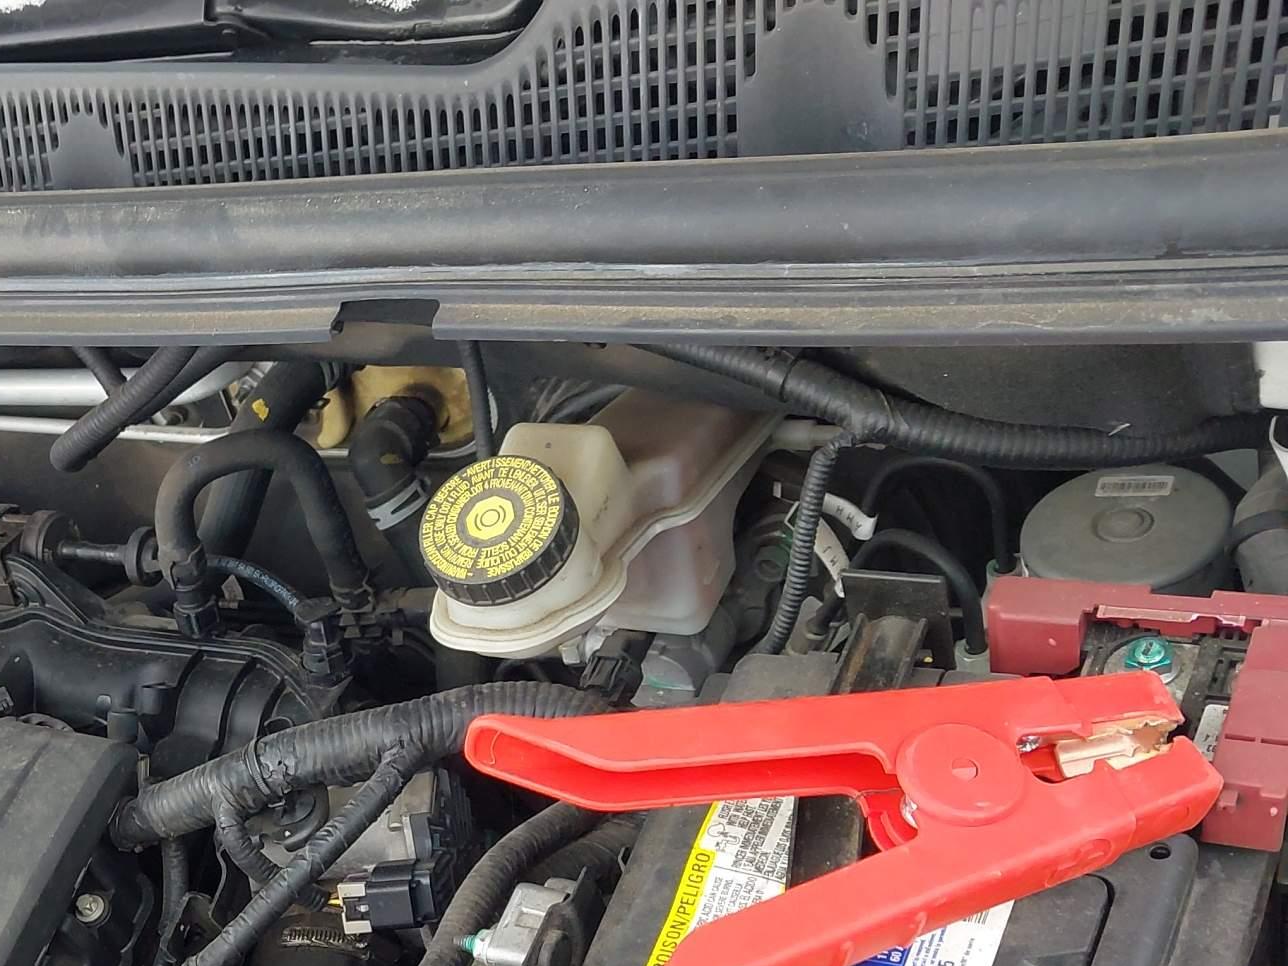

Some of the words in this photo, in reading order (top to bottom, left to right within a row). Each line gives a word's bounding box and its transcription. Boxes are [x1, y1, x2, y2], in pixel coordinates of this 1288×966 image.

[424, 503, 441, 519] CAP
[433, 474, 463, 503] BEFORE
[548, 491, 560, 503] LE
[437, 501, 453, 513] DOT
[449, 480, 471, 499] FLUID
[469, 468, 494, 486] AVANT
